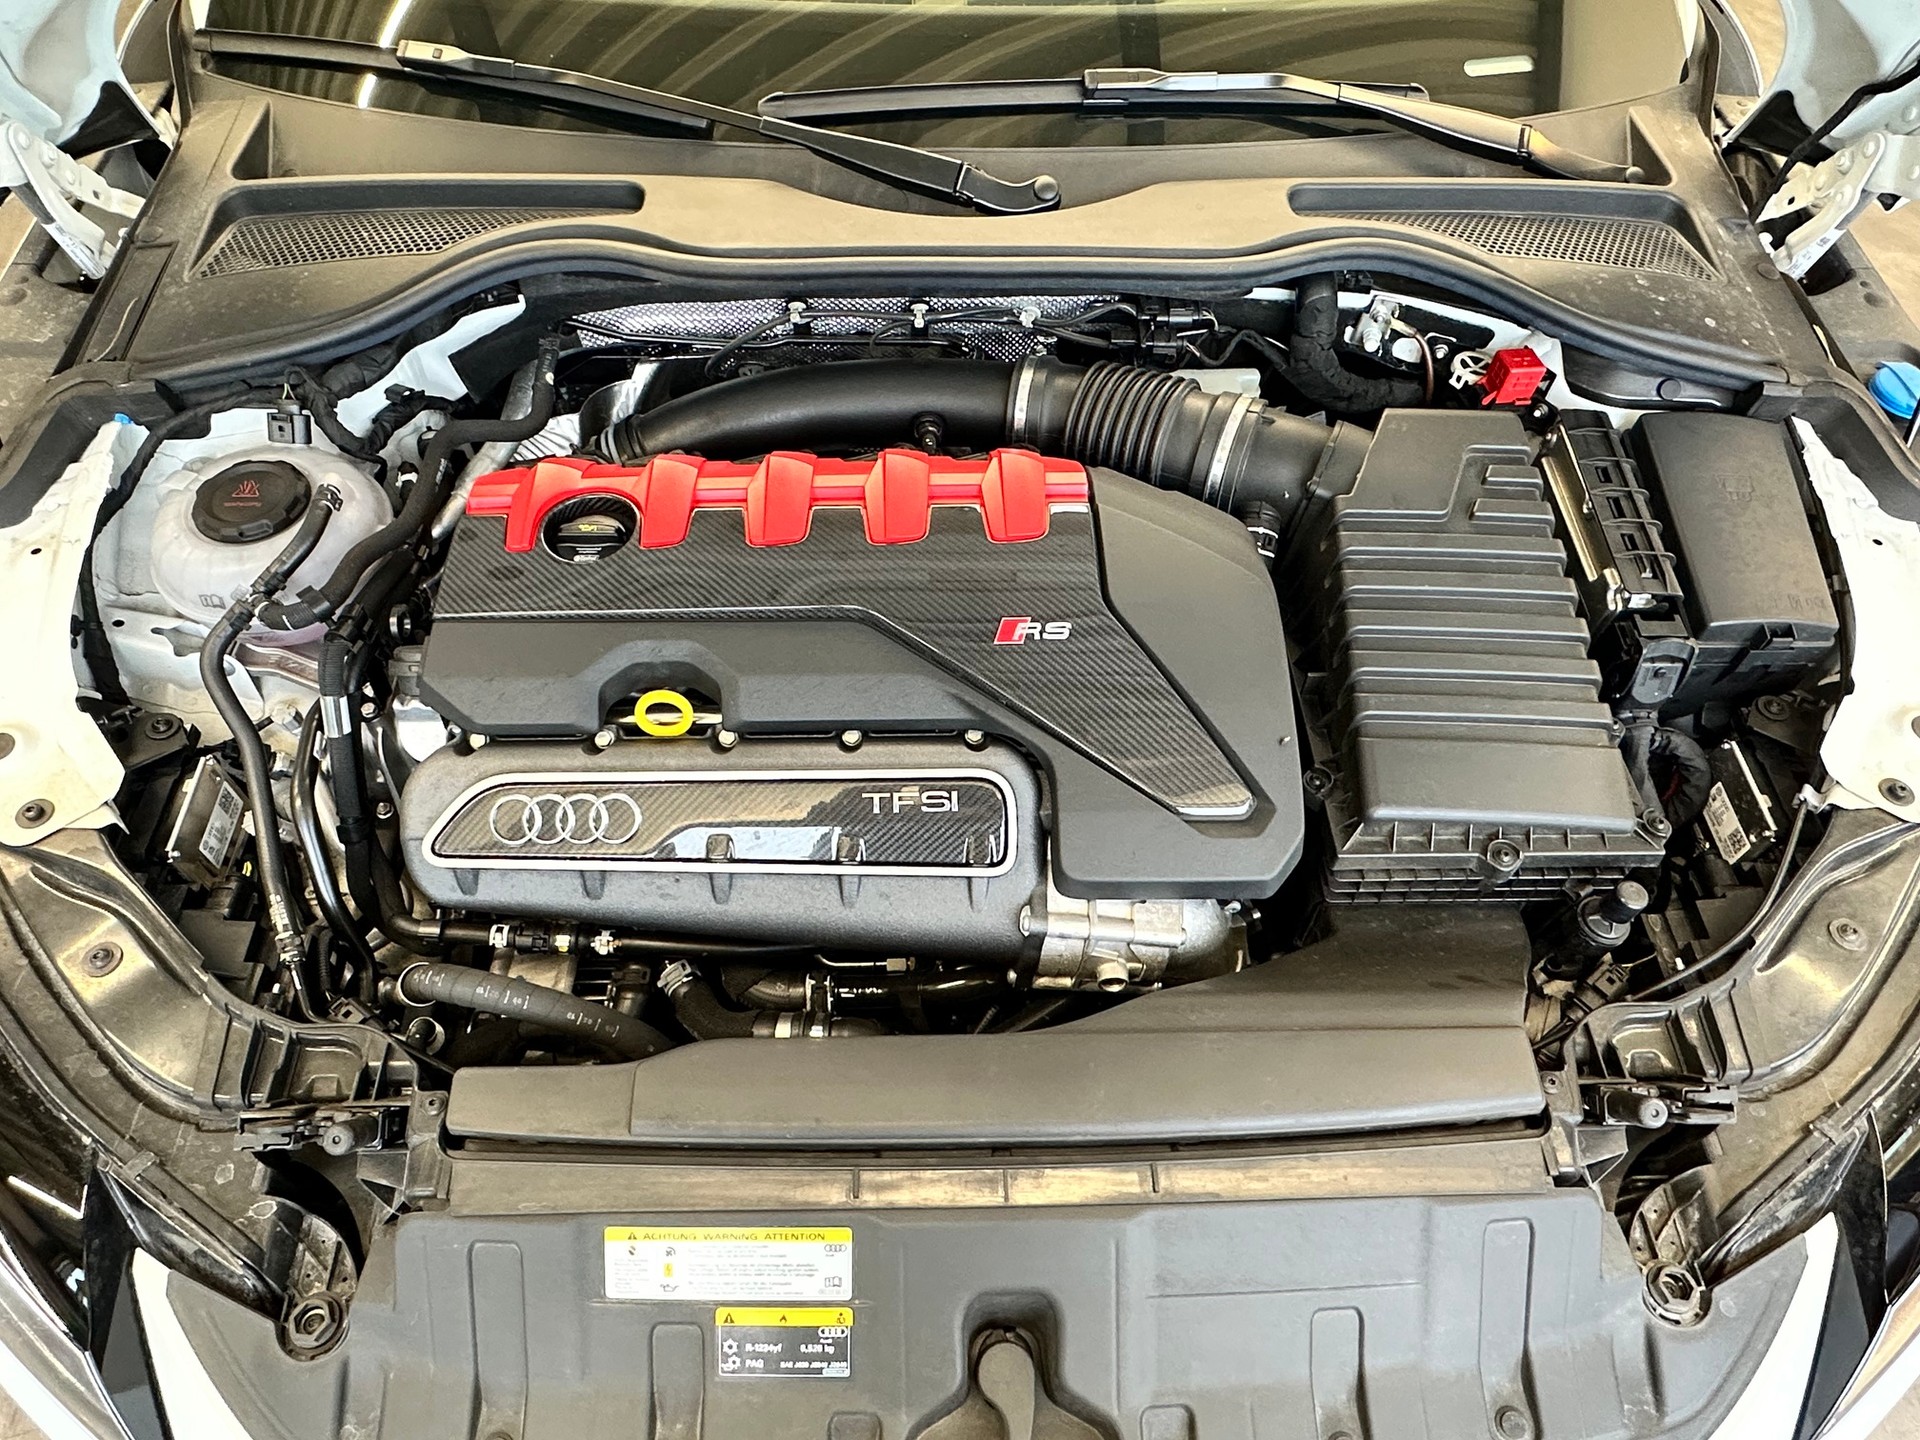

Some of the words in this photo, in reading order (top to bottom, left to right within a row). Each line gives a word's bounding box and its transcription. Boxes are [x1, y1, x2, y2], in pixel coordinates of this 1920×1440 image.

[1010, 620, 1073, 641] RS
[861, 790, 959, 814] TFSI
[643, 1232, 697, 1241] ACHTUNG
[703, 1232, 758, 1241] WARNING
[764, 1232, 826, 1241] ATTENTION
